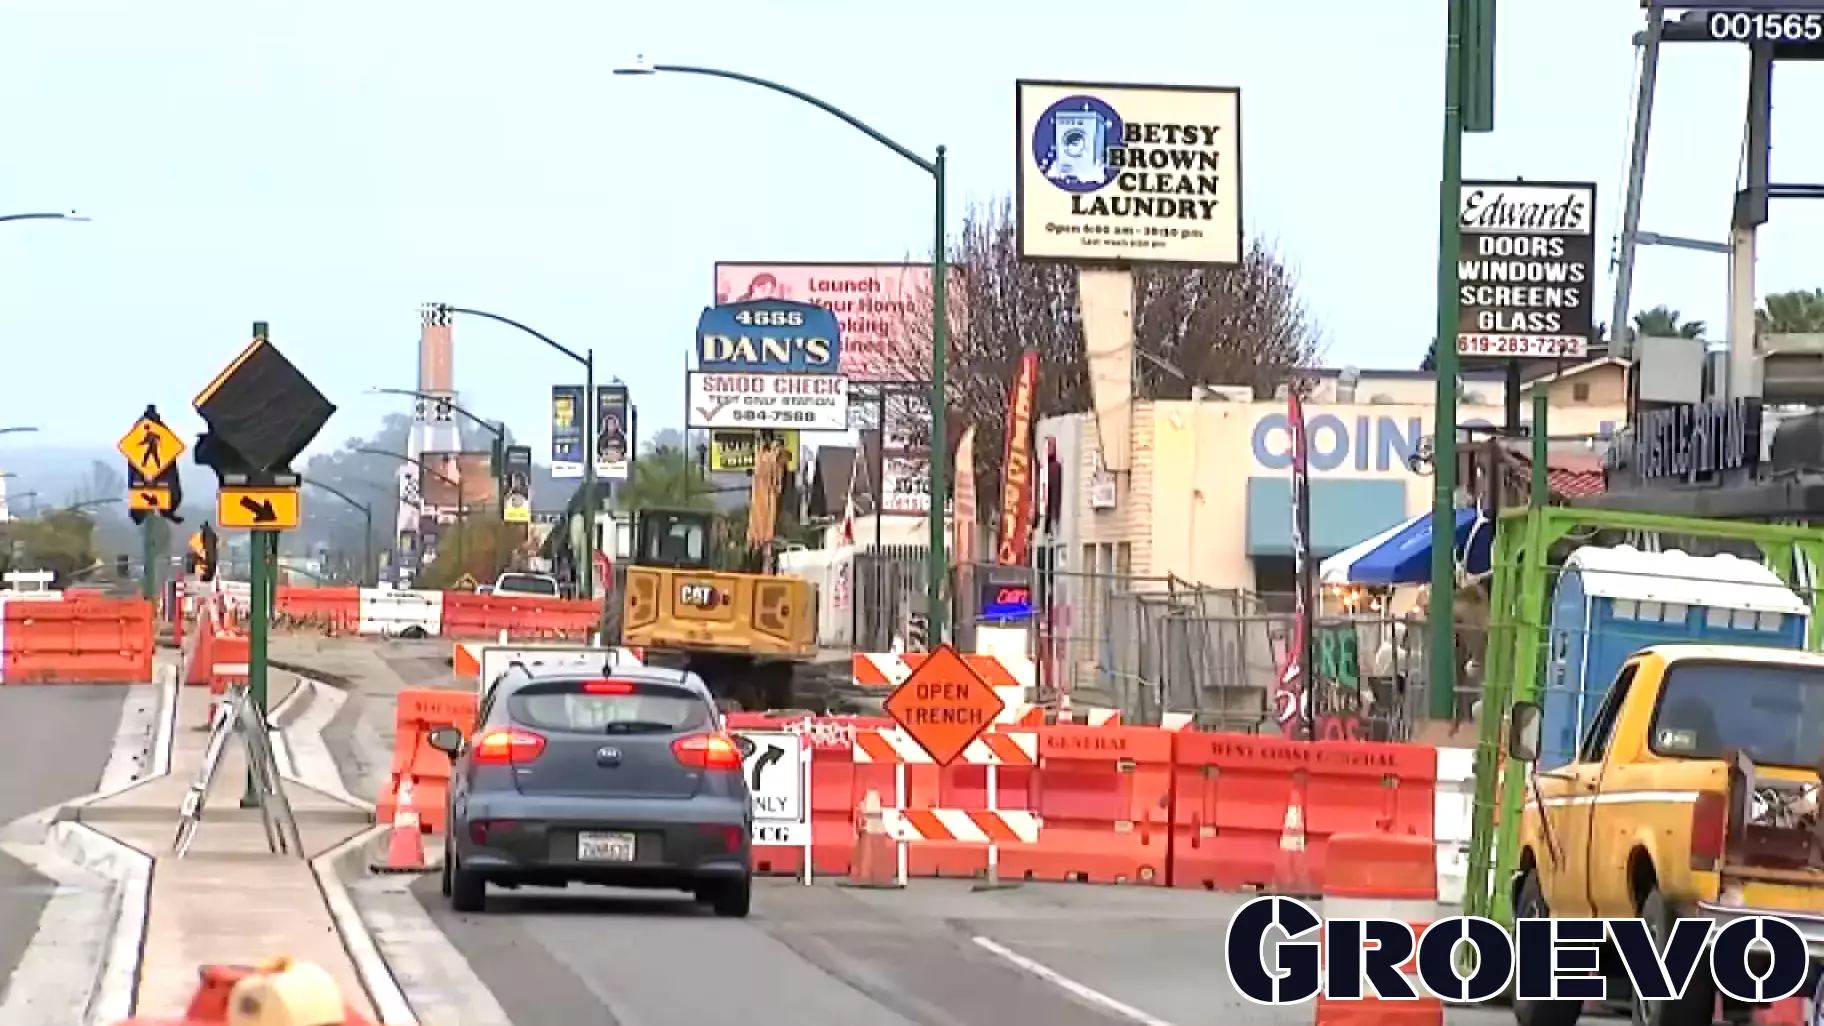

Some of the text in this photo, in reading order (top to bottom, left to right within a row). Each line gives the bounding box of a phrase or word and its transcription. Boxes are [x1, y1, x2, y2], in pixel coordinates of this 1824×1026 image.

[1711, 13, 1821, 39] 001565
[1124, 123, 1220, 145] BETSY
[1109, 148, 1220, 171] BROWN
[1119, 172, 1220, 195] CLEAN
[1071, 195, 1219, 220] LAUNDRY
[1460, 189, 1585, 229] Edwards
[1479, 236, 1564, 257] DOORS
[1458, 260, 1585, 283] WINDOWS
[809, 276, 881, 293] Launch
[1460, 285, 1580, 308] SCREENS
[1479, 310, 1561, 333] GLASS
[703, 333, 831, 364] DAN'S
[773, 377, 842, 395] CHECK
[1251, 412, 1421, 472] COIN
[681, 585, 711, 605] CAT
[916, 684, 969, 700] OPEN
[904, 707, 983, 724] TRENCH
[752, 796, 788, 812] NLY
